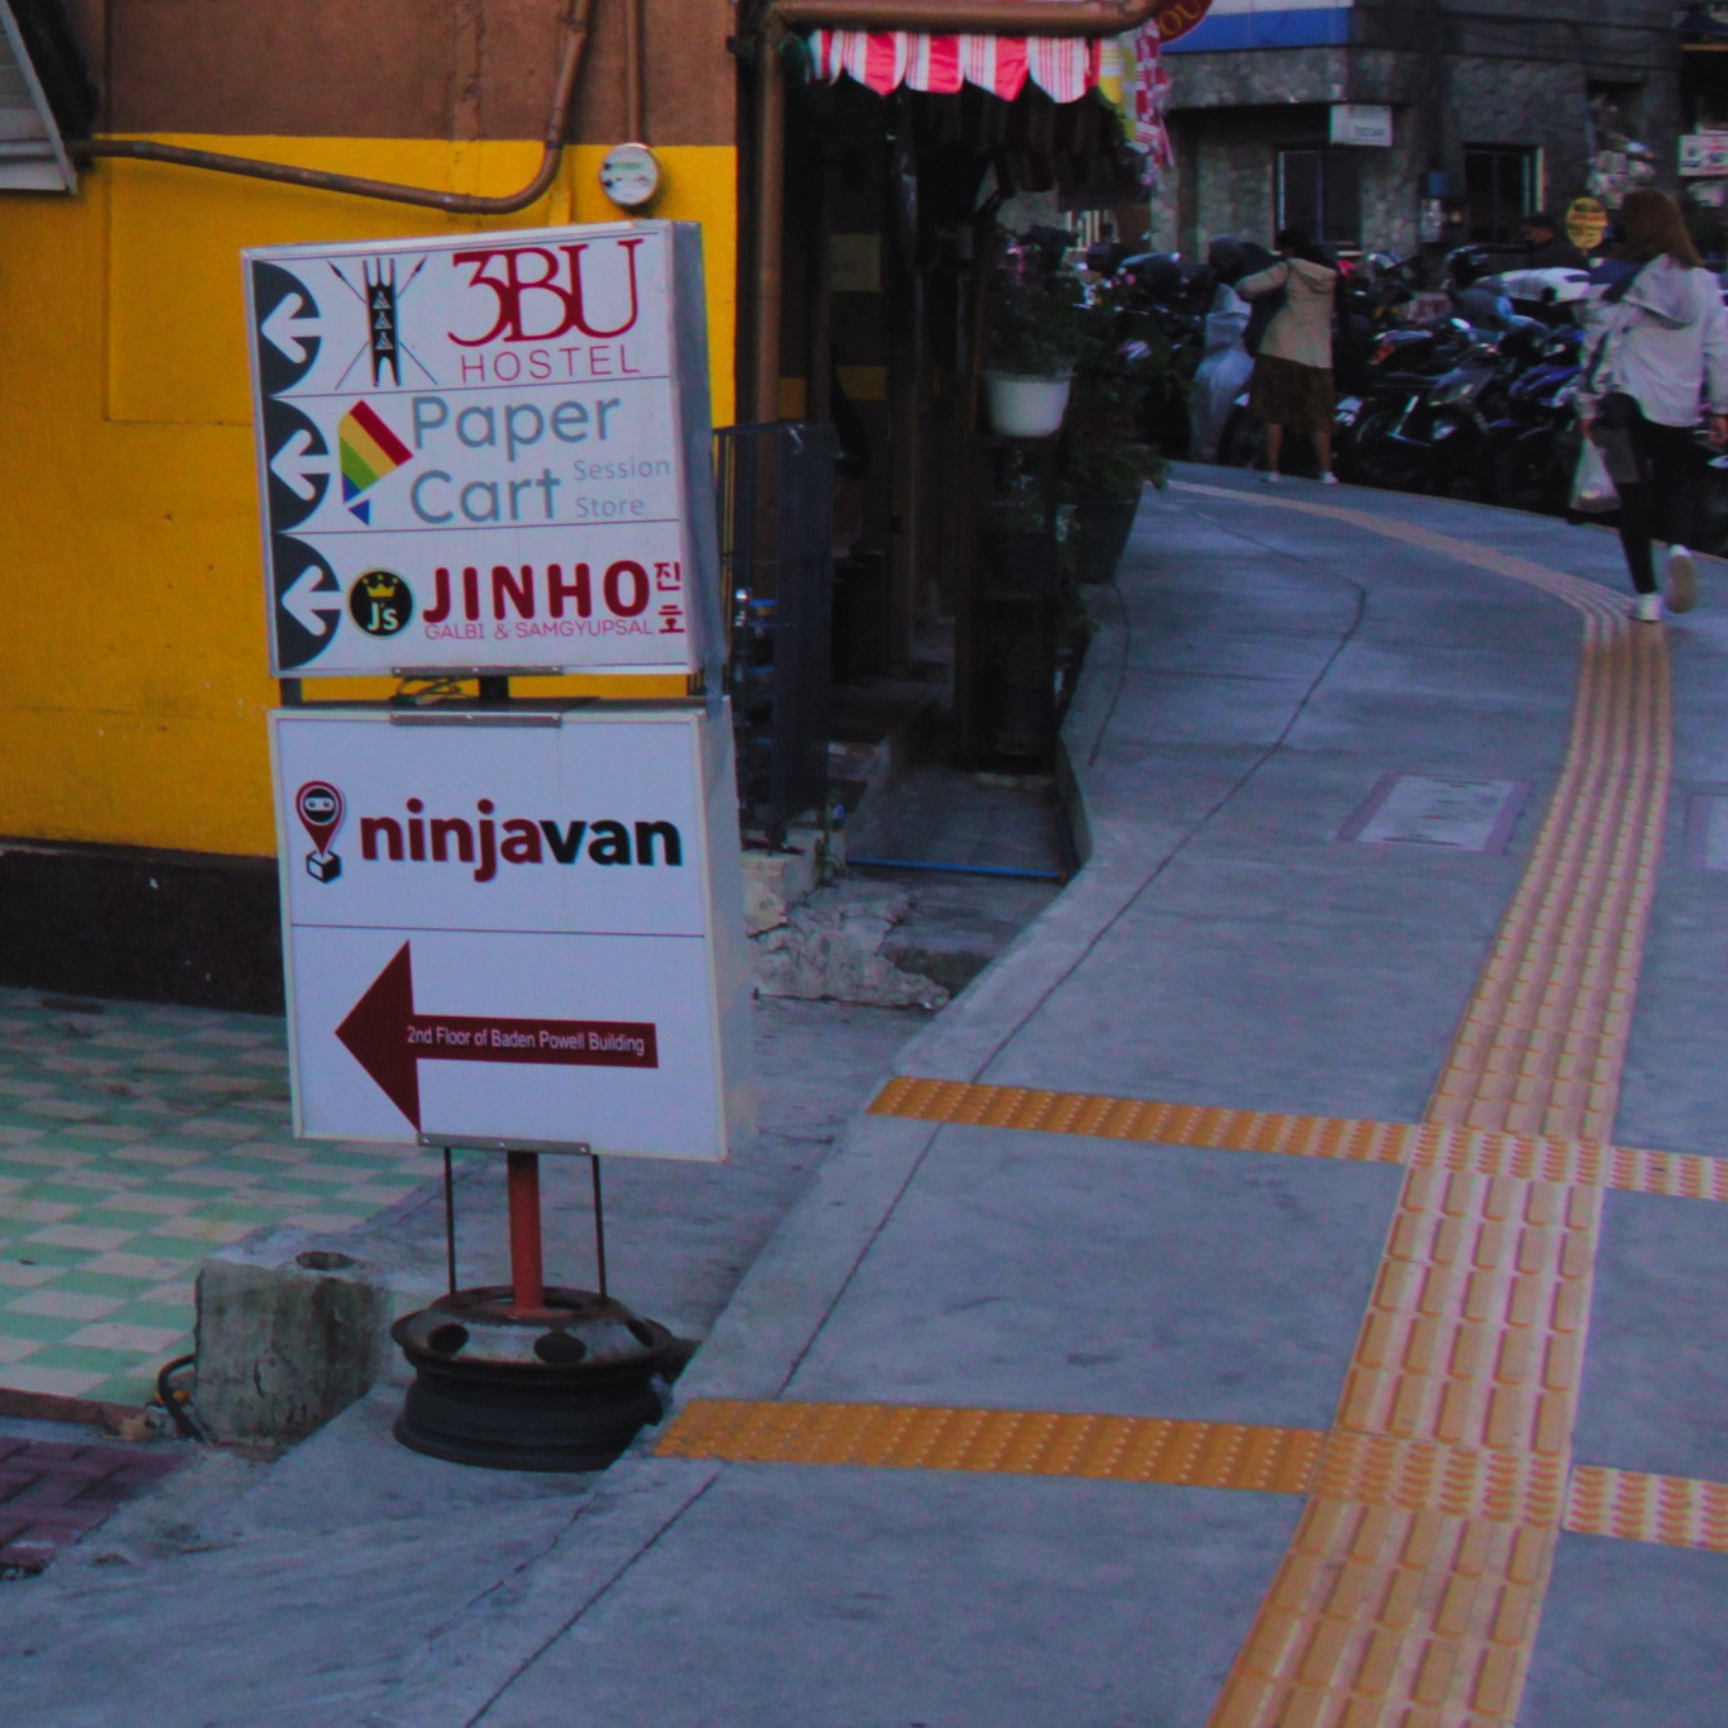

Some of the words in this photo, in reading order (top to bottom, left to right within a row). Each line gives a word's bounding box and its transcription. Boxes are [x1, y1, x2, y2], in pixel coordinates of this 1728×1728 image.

[446, 238, 644, 347] 3BU
[460, 344, 640, 384] HOSTEL
[411, 395, 621, 462] Paper
[572, 458, 671, 482] Session
[410, 467, 561, 524] Cart
[575, 495, 645, 519] Store
[422, 560, 650, 625] JINHO
[424, 622, 486, 642] GALBI
[493, 620, 510, 641] &
[515, 618, 653, 639] SAMGYUPSAL
[359, 796, 684, 883] ninjavan
[406, 1024, 433, 1044] 2nd
[435, 1025, 471, 1046] Floor
[473, 1027, 488, 1046] of
[491, 1028, 536, 1048] Baden
[538, 1030, 586, 1050] Powell
[588, 1031, 646, 1057] Building
